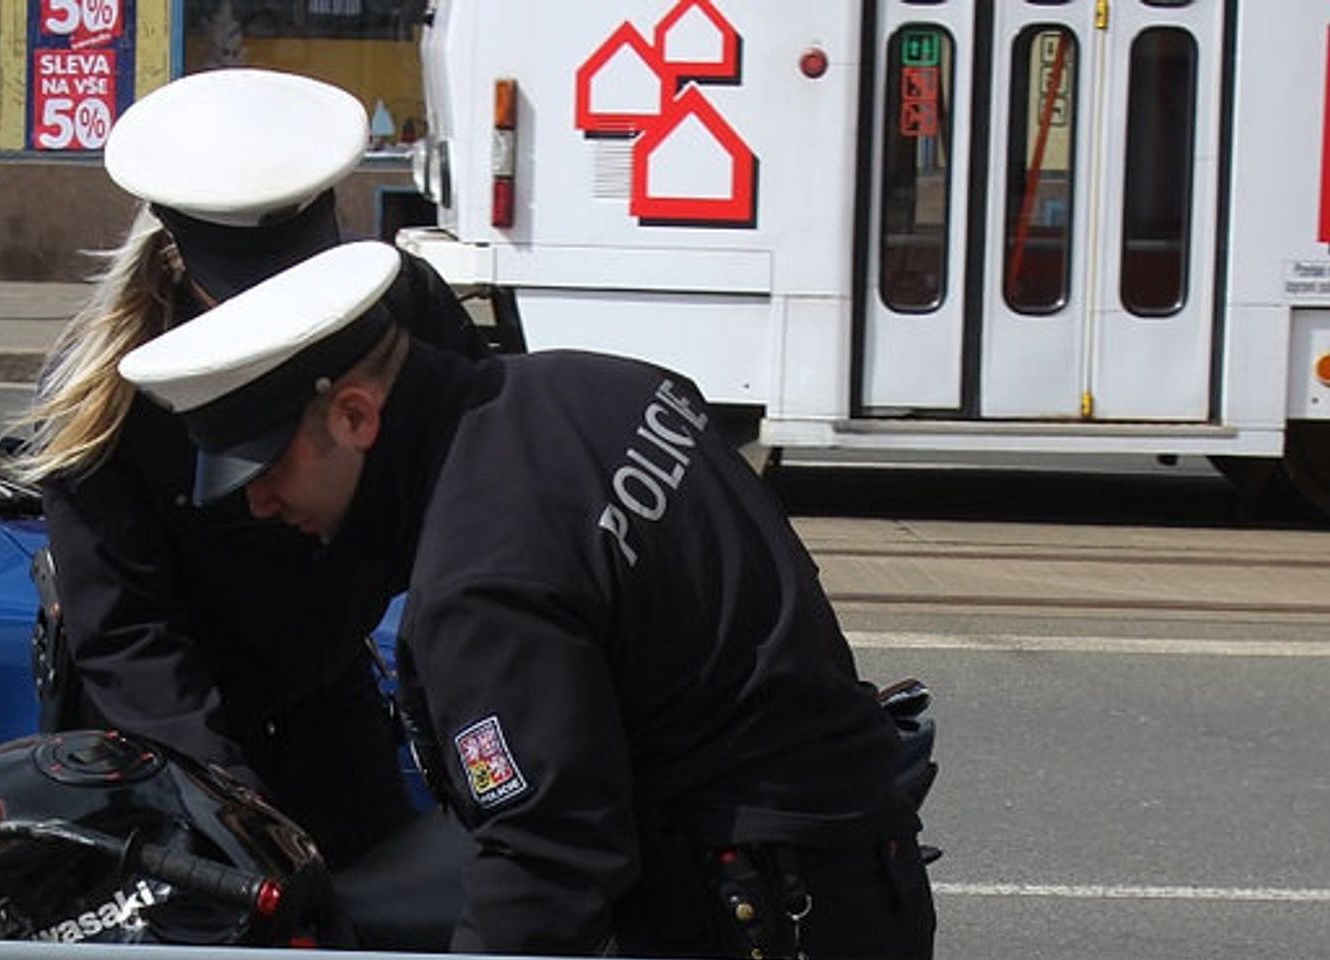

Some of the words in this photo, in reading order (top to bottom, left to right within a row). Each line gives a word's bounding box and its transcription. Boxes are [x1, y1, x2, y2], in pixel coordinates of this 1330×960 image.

[40, 54, 110, 75] SLEVA
[41, 77, 70, 95] NA
[73, 75, 108, 95] VŠE
